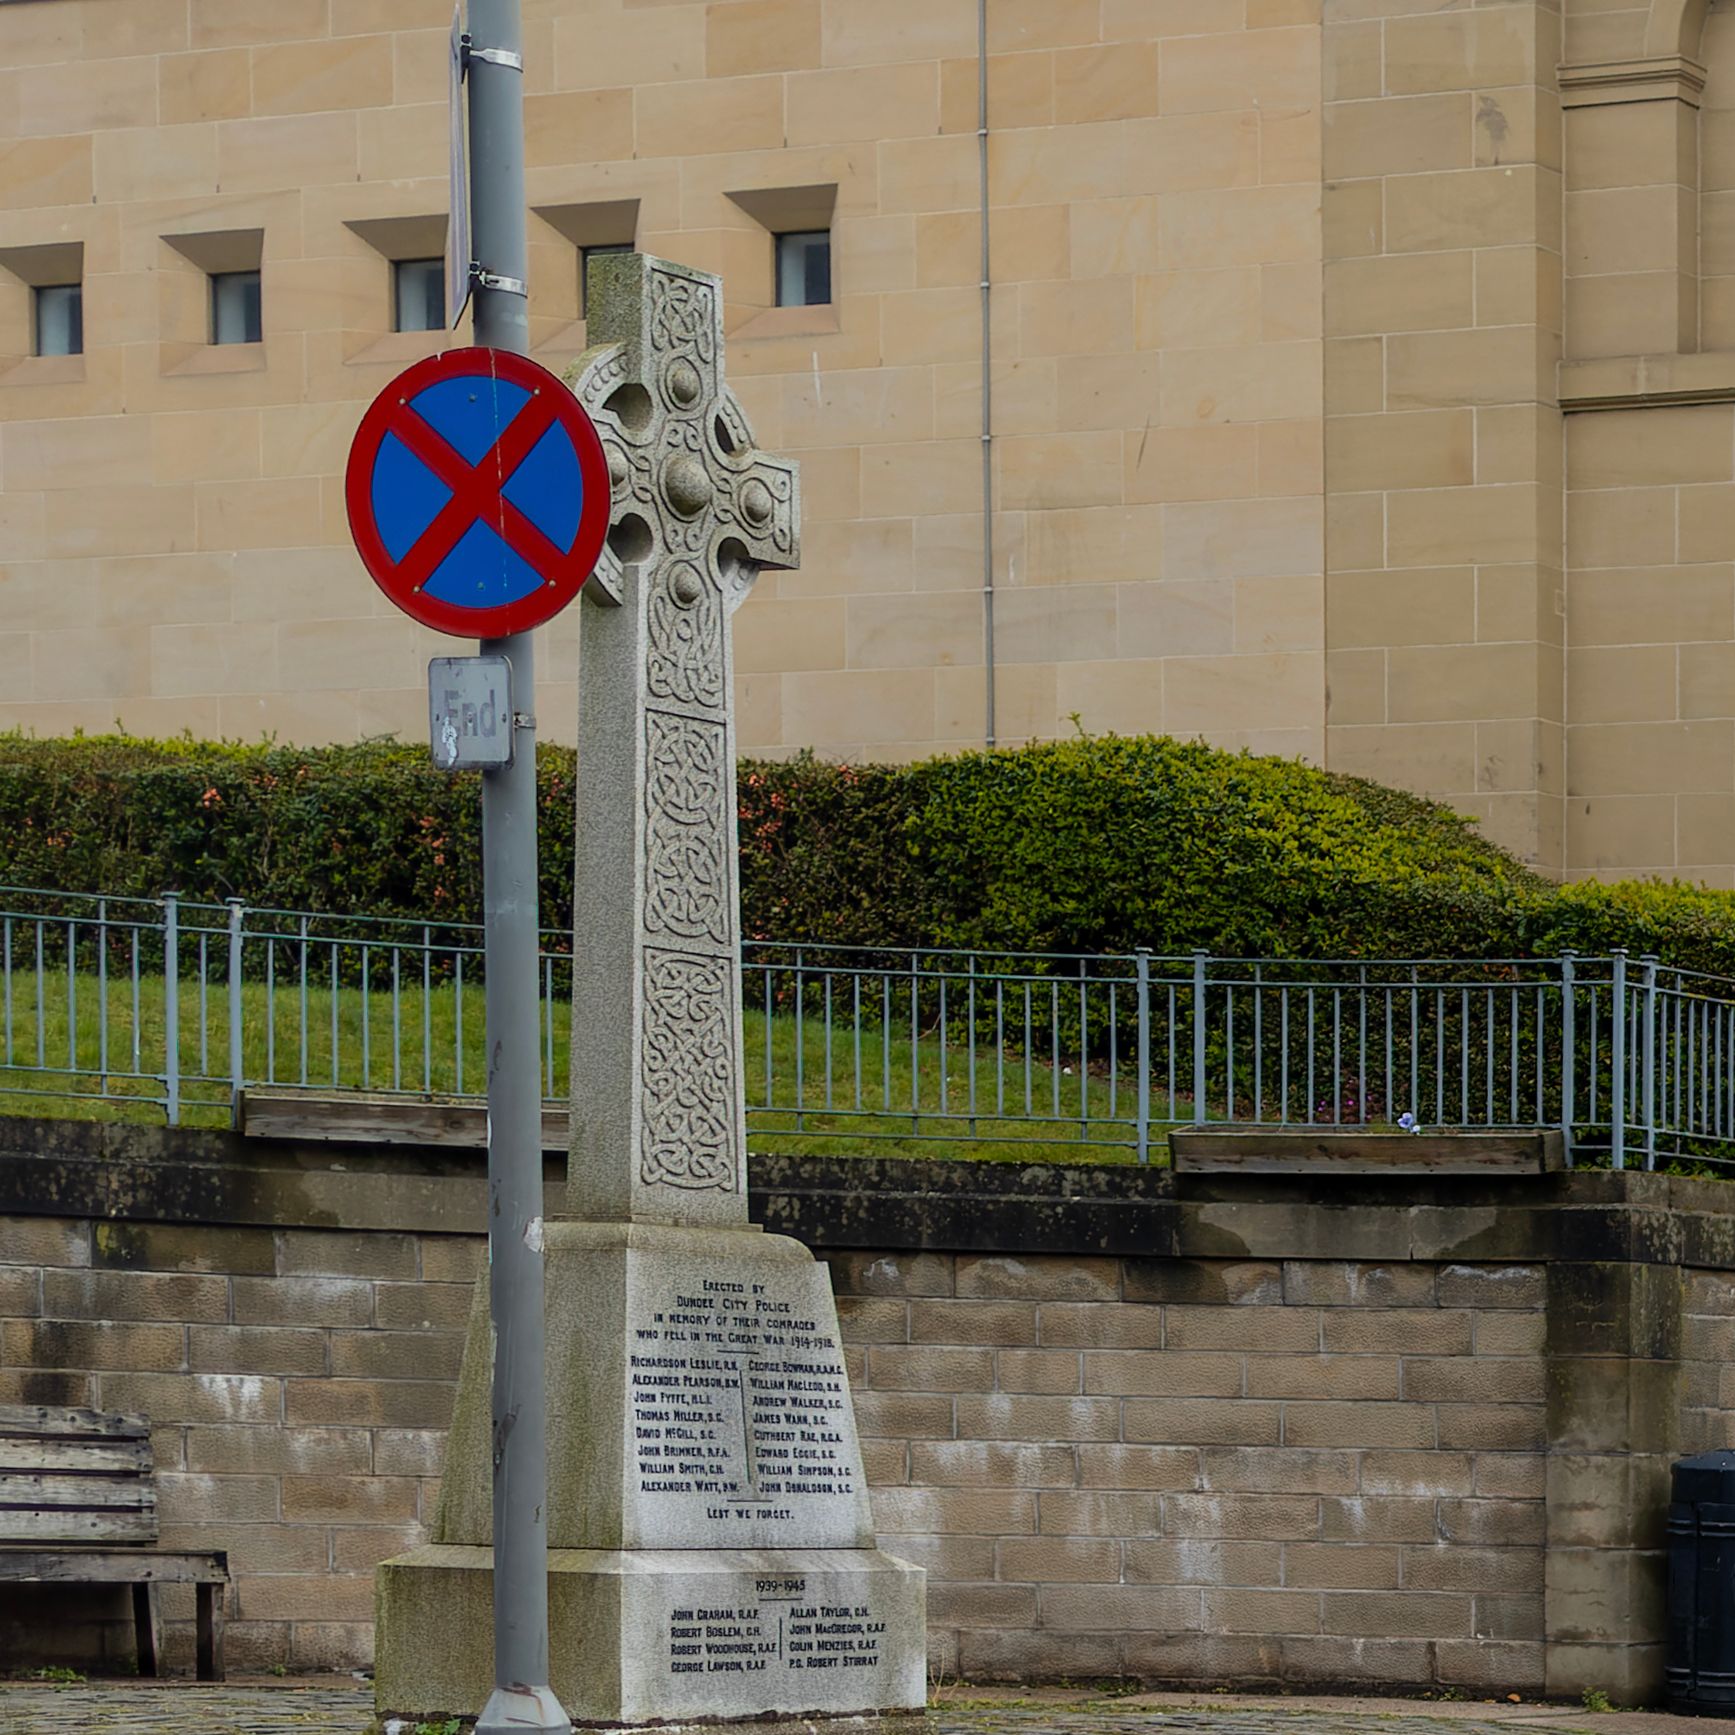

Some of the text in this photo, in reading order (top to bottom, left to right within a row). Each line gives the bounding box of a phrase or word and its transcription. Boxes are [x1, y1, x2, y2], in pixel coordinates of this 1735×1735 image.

[444, 689, 496, 737] End
[703, 1280, 765, 1294] ERECTED BY
[677, 1296, 790, 1313] DUNDEE CITY POLICE
[654, 1313, 816, 1331] IN MEMORY OF THEIR COMRADES
[637, 1329, 658, 1339] WHO
[664, 1331, 686, 1340] FELL
[691, 1331, 700, 1341] IN
[706, 1332, 723, 1342] THE
[728, 1332, 757, 1344] GREAT
[763, 1334, 784, 1345] WAR
[631, 1356, 686, 1368] RICHARDSON
[632, 1374, 680, 1386] ALEXANDER
[750, 1378, 784, 1390] WILLIAM
[634, 1391, 656, 1403] JOHN
[752, 1395, 786, 1407] ANDREW
[635, 1409, 669, 1421] THOMAS
[753, 1412, 780, 1424] JAMES
[636, 1427, 661, 1439] DAVID
[754, 1430, 796, 1441] CUTHBERT
[638, 1445, 660, 1456] JOHN
[755, 1447, 788, 1458] EDWARD
[639, 1462, 674, 1474] WILLIAM
[679, 1462, 708, 1476] SMITH,
[757, 1464, 792, 1475] WILLIAM
[798, 1465, 836, 1477] SIMPSON,
[641, 1480, 691, 1492] ALEXANDER
[759, 1481, 781, 1492] JOHN
[707, 1508, 729, 1519] LEST
[735, 1509, 751, 1519] WE
[756, 1580, 806, 1592] 1939-1945
[671, 1609, 693, 1620] JOHN
[789, 1607, 817, 1618] ALLAN
[671, 1627, 702, 1638] ROBERT
[789, 1624, 811, 1635] JOHN
[671, 1644, 702, 1655] ROBERT
[807, 1657, 838, 1668] ROBERT
[843, 1656, 878, 1666] STIRRAT
